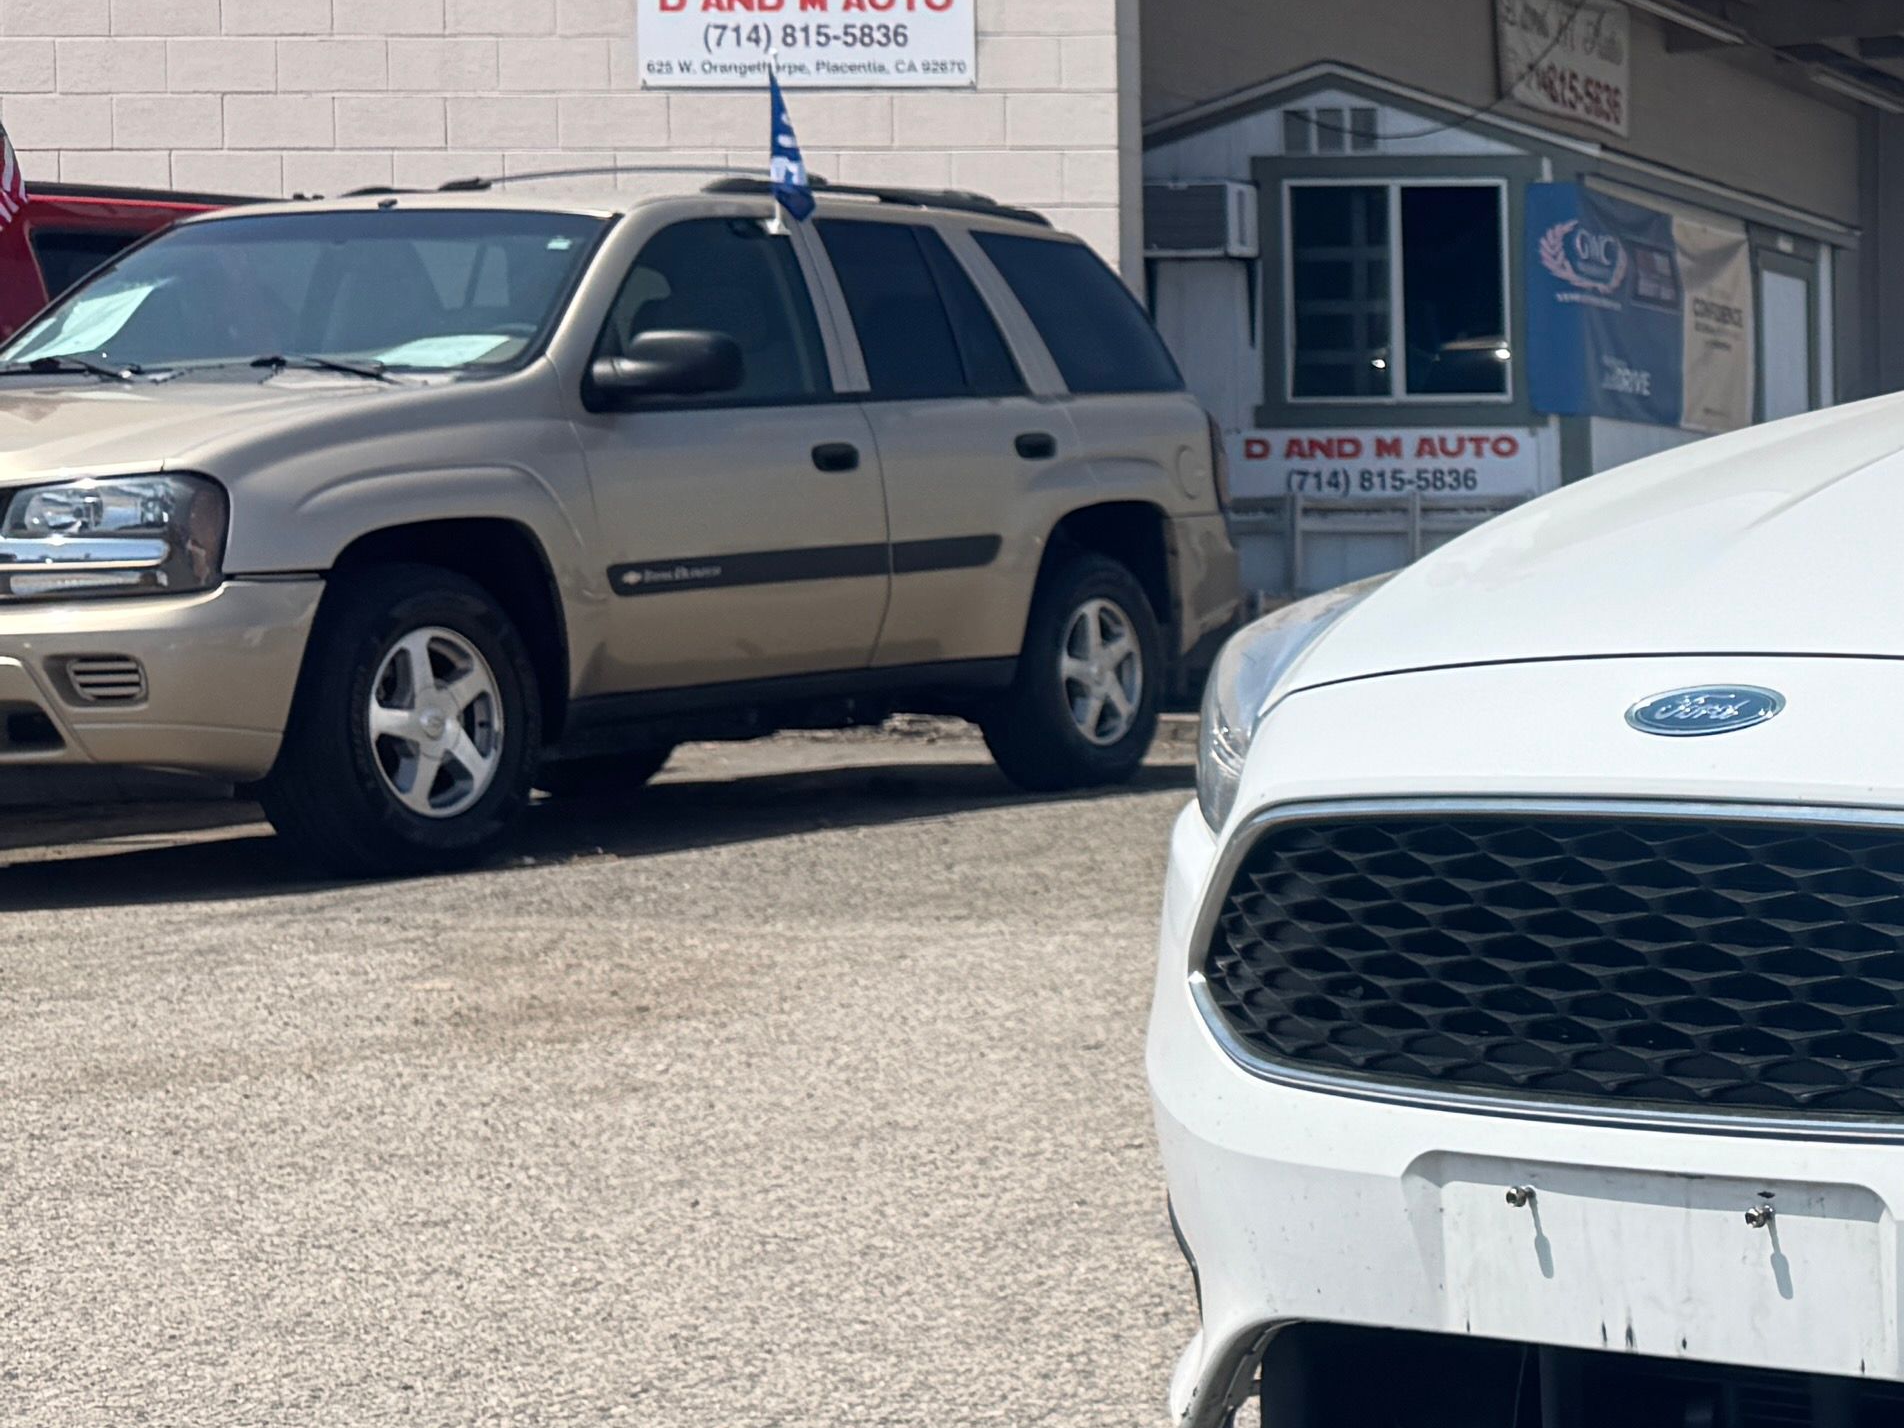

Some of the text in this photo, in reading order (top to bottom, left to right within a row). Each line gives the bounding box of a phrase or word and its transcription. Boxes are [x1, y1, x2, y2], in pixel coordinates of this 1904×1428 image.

[703, 23, 909, 54] (714) 815-5836
[894, 59, 918, 73] CA
[1243, 434, 1520, 460] D AND M AUTO
[1286, 468, 1478, 496] (714) 815-5836
